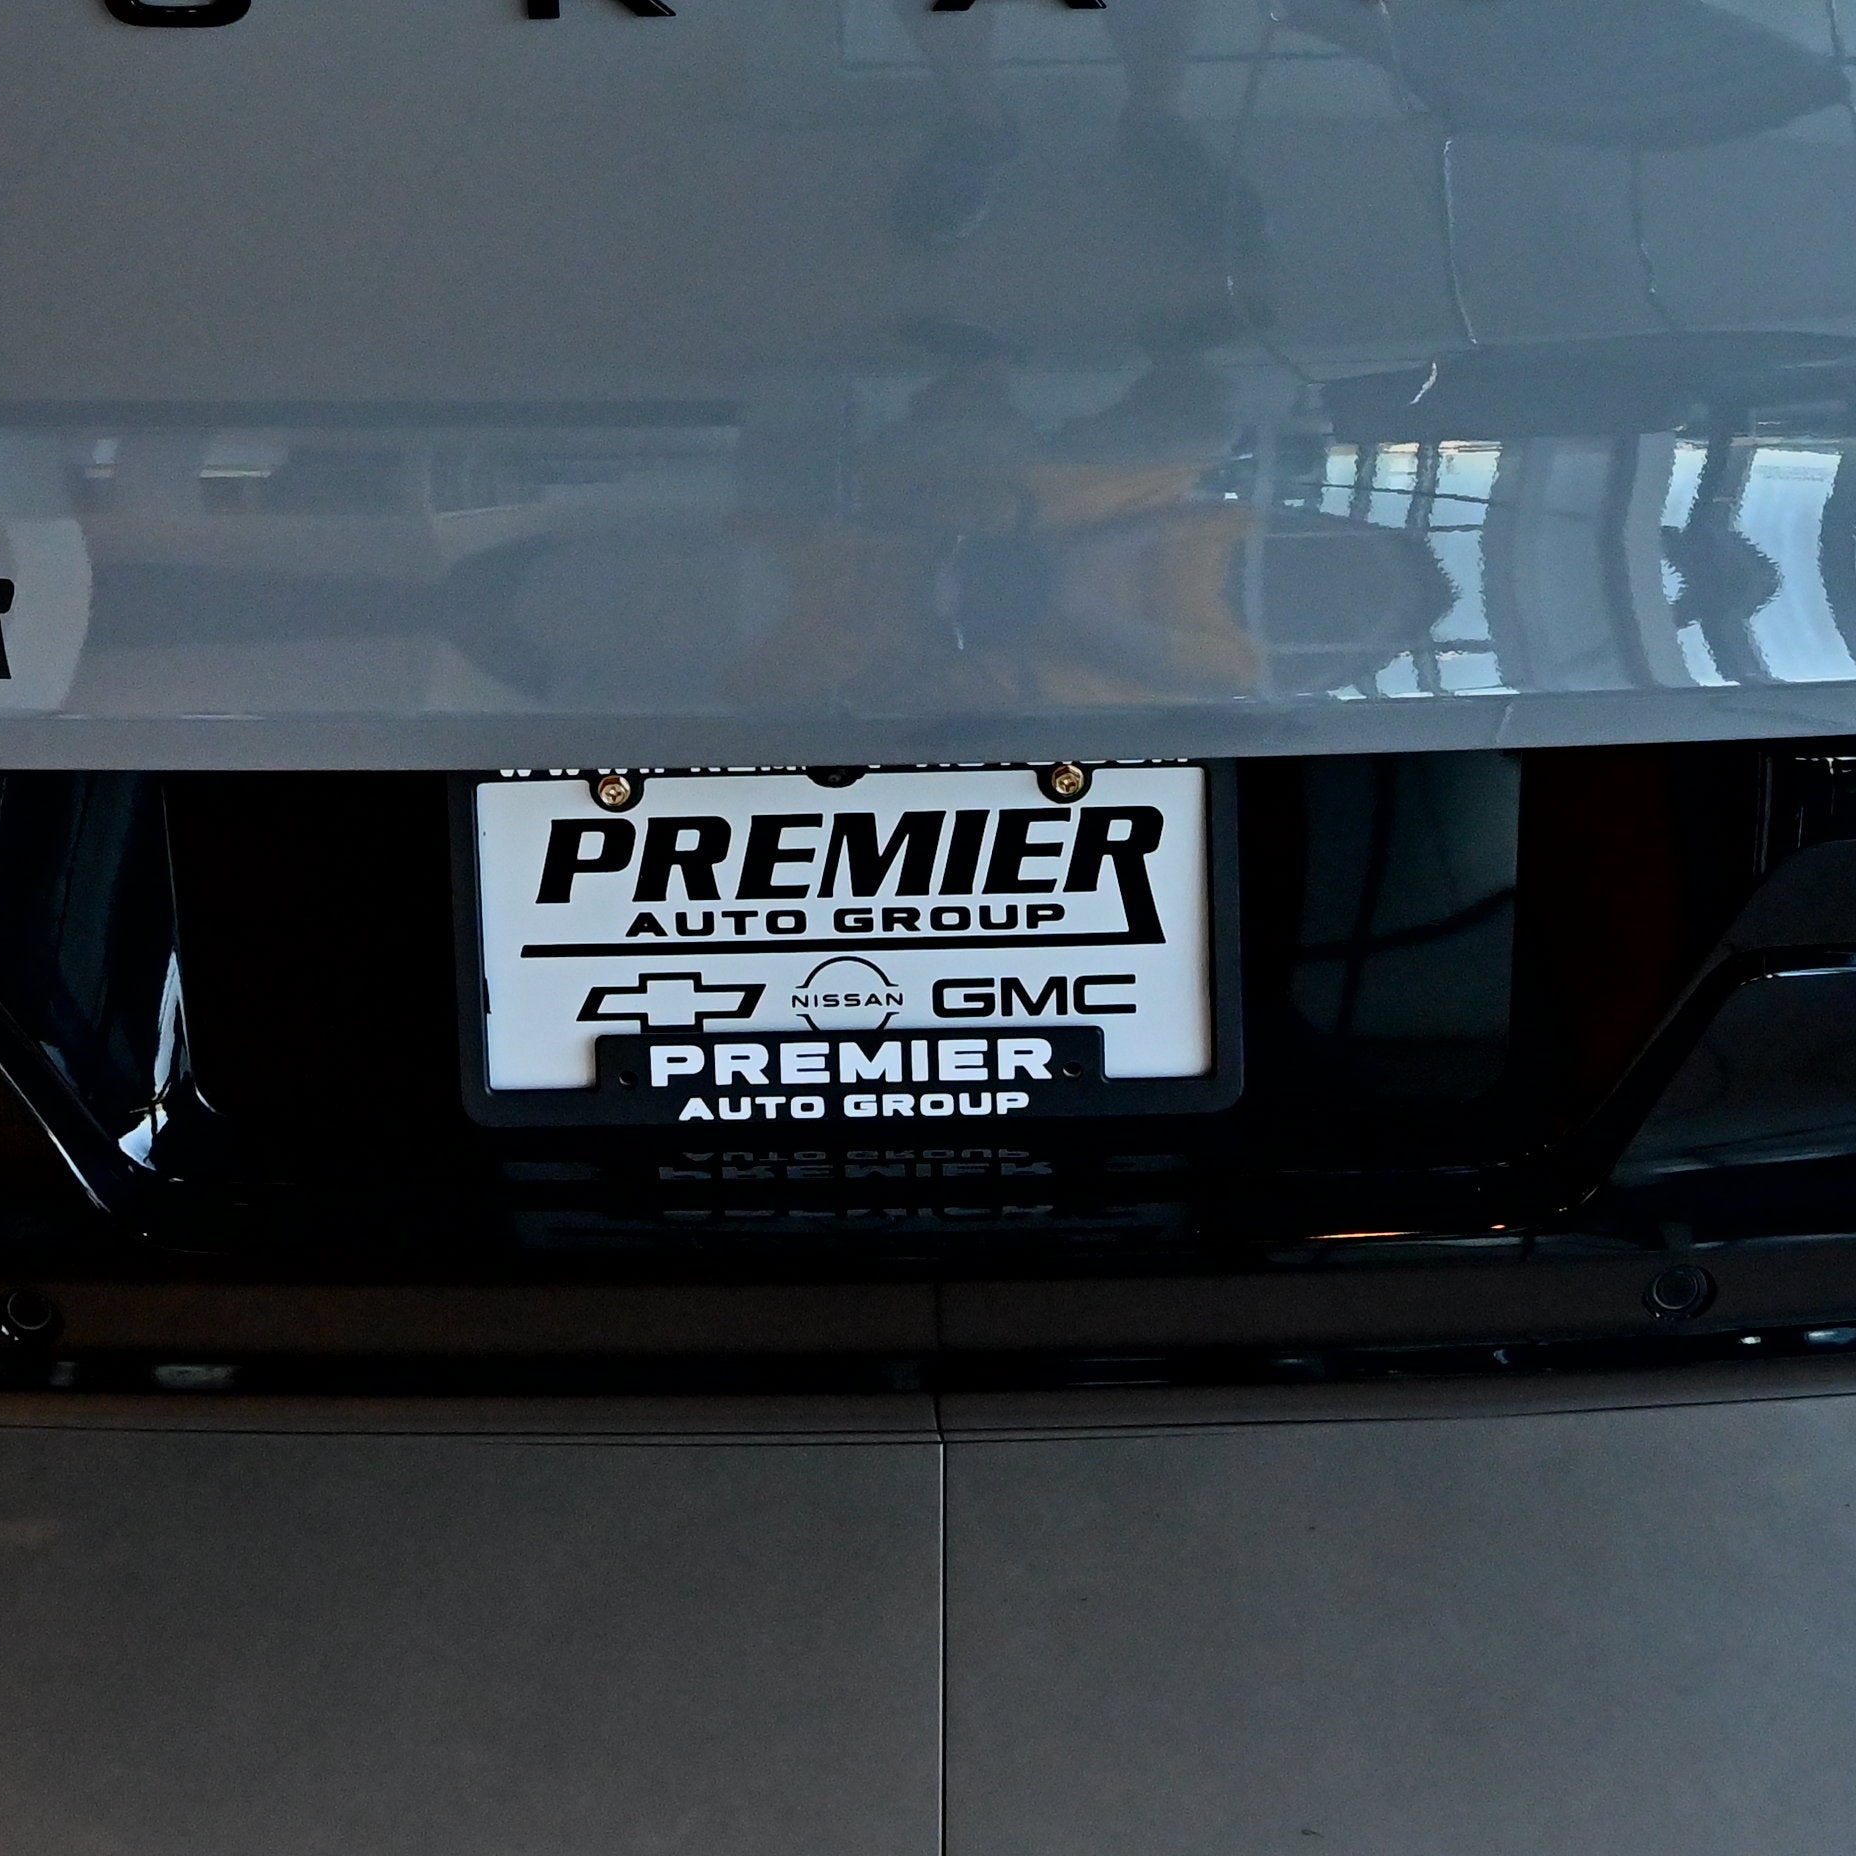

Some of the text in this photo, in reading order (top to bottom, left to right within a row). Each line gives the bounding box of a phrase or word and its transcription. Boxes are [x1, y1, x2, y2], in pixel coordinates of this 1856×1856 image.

[534, 804, 1165, 906] PREMIER
[624, 902, 1067, 939] AUTO GROUP
[790, 989, 905, 1009] NISSAN
[930, 973, 1138, 1019] GMC
[649, 1037, 1055, 1088] PREMIER
[677, 1090, 1032, 1122] AUTO GROUP
